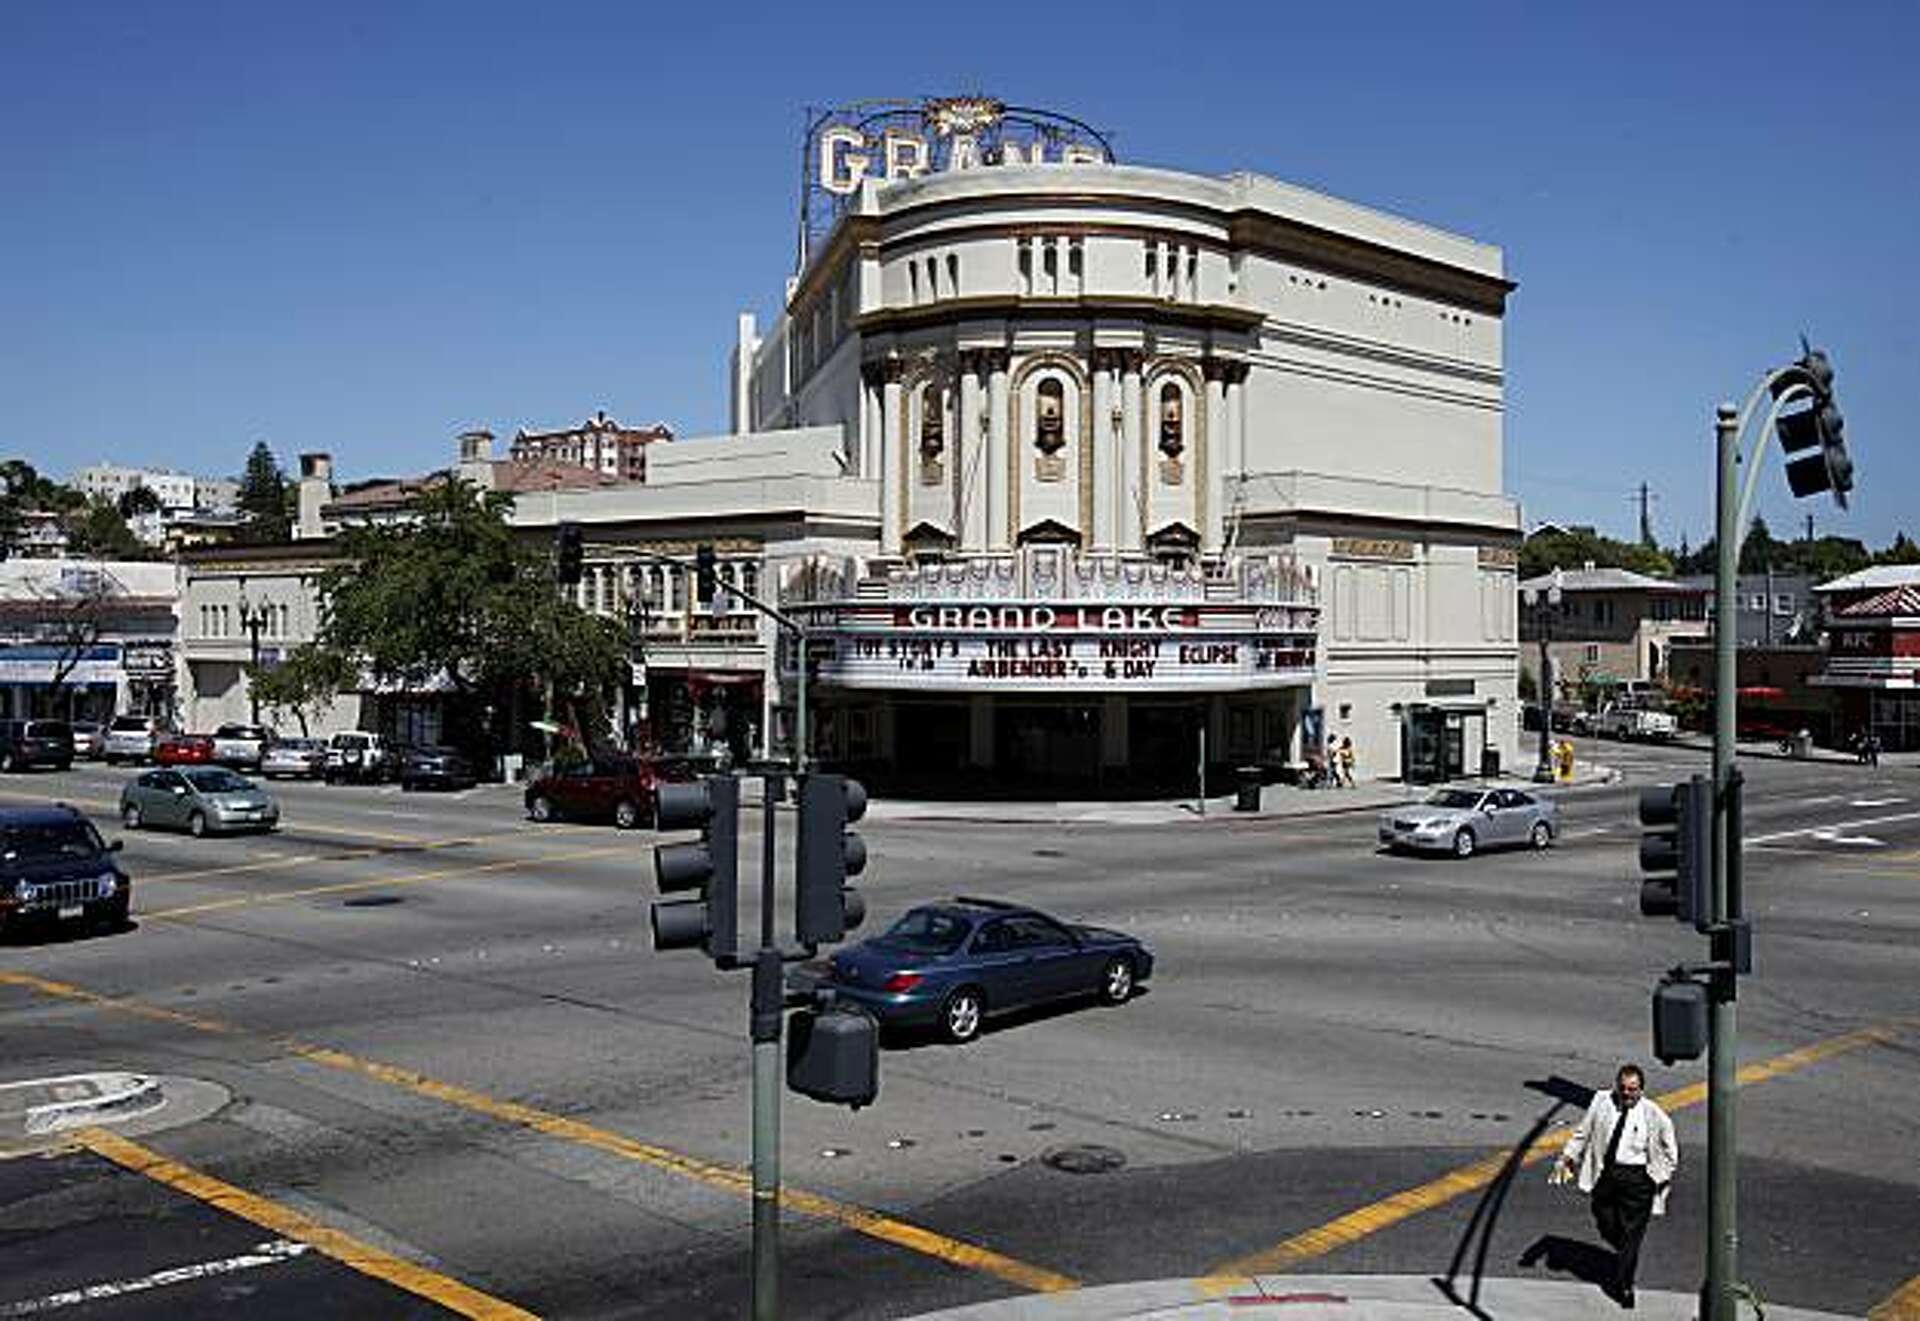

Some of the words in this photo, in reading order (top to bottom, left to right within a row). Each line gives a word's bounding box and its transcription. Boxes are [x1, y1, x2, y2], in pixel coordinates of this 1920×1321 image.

[909, 606, 1055, 630] GRAND
[1076, 607, 1184, 632] LAKE
[985, 639, 1018, 658] THE
[1027, 639, 1074, 658] LAST
[1099, 638, 1162, 658] KNIGHT
[1179, 644, 1239, 664] ECLIPSE
[967, 660, 1067, 678] AIRBENDER
[1123, 660, 1156, 678] DAY
